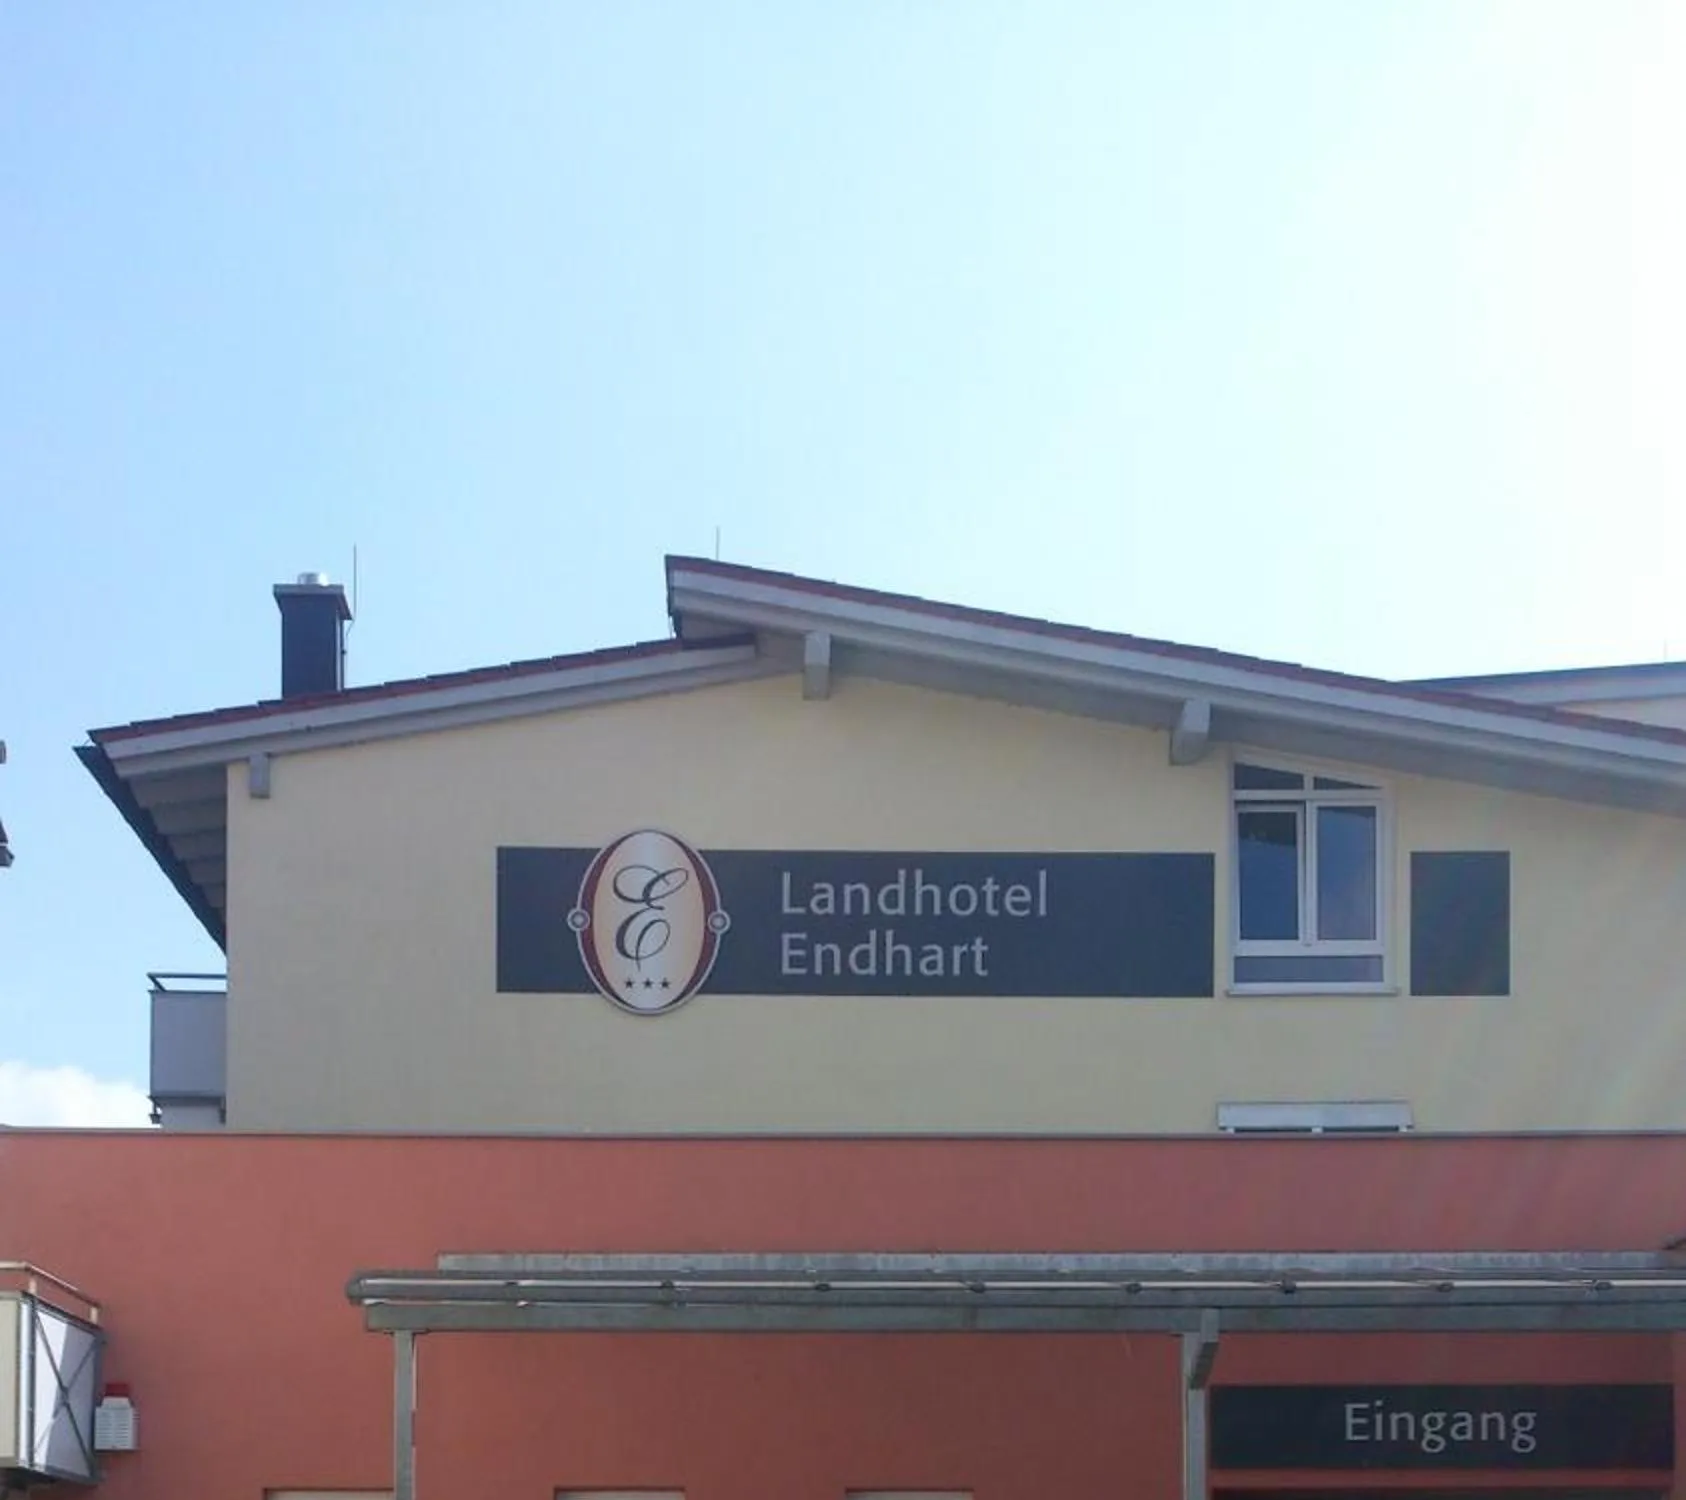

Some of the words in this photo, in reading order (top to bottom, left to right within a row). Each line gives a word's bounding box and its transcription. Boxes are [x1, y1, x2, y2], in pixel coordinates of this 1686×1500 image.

[781, 870, 1049, 917] Landhotel
[781, 929, 990, 978] Endhart
[1344, 1399, 1538, 1453] Eingang
